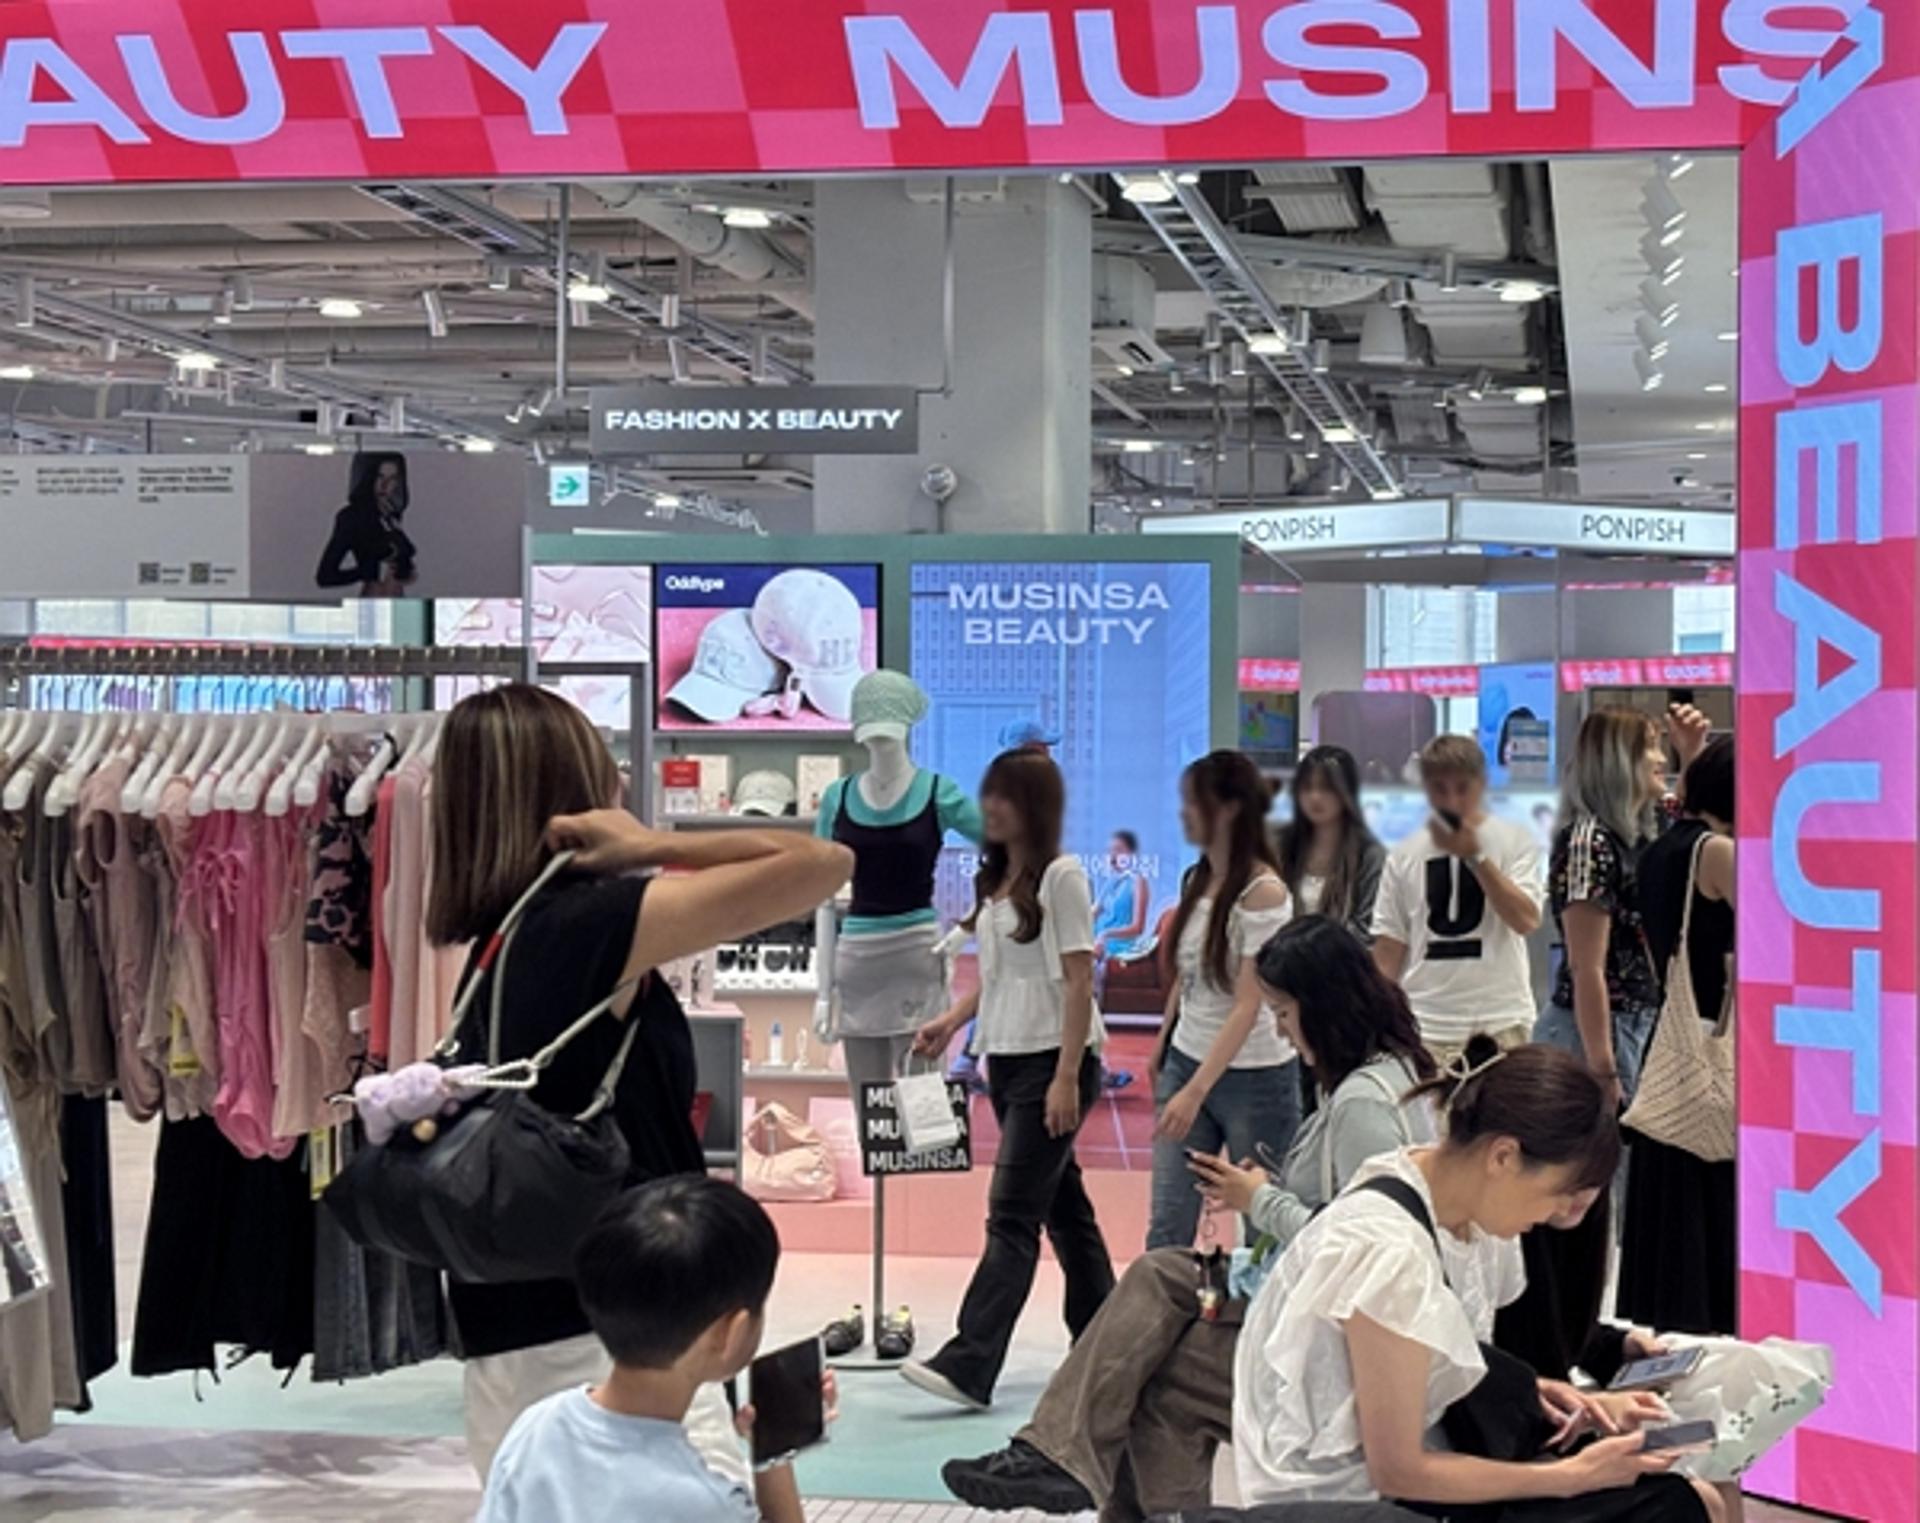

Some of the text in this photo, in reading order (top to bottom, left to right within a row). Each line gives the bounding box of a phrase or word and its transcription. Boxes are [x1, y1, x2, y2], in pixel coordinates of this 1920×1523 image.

[605, 408, 902, 430] FASHION X BEAUTY
[1242, 515, 1336, 541] PONPISH
[1581, 514, 1685, 542] PONPISH
[949, 582, 1170, 610] MUSINSA
[964, 617, 1155, 645] BEAUTY
[1773, 212, 1884, 1319] BEAUTY
